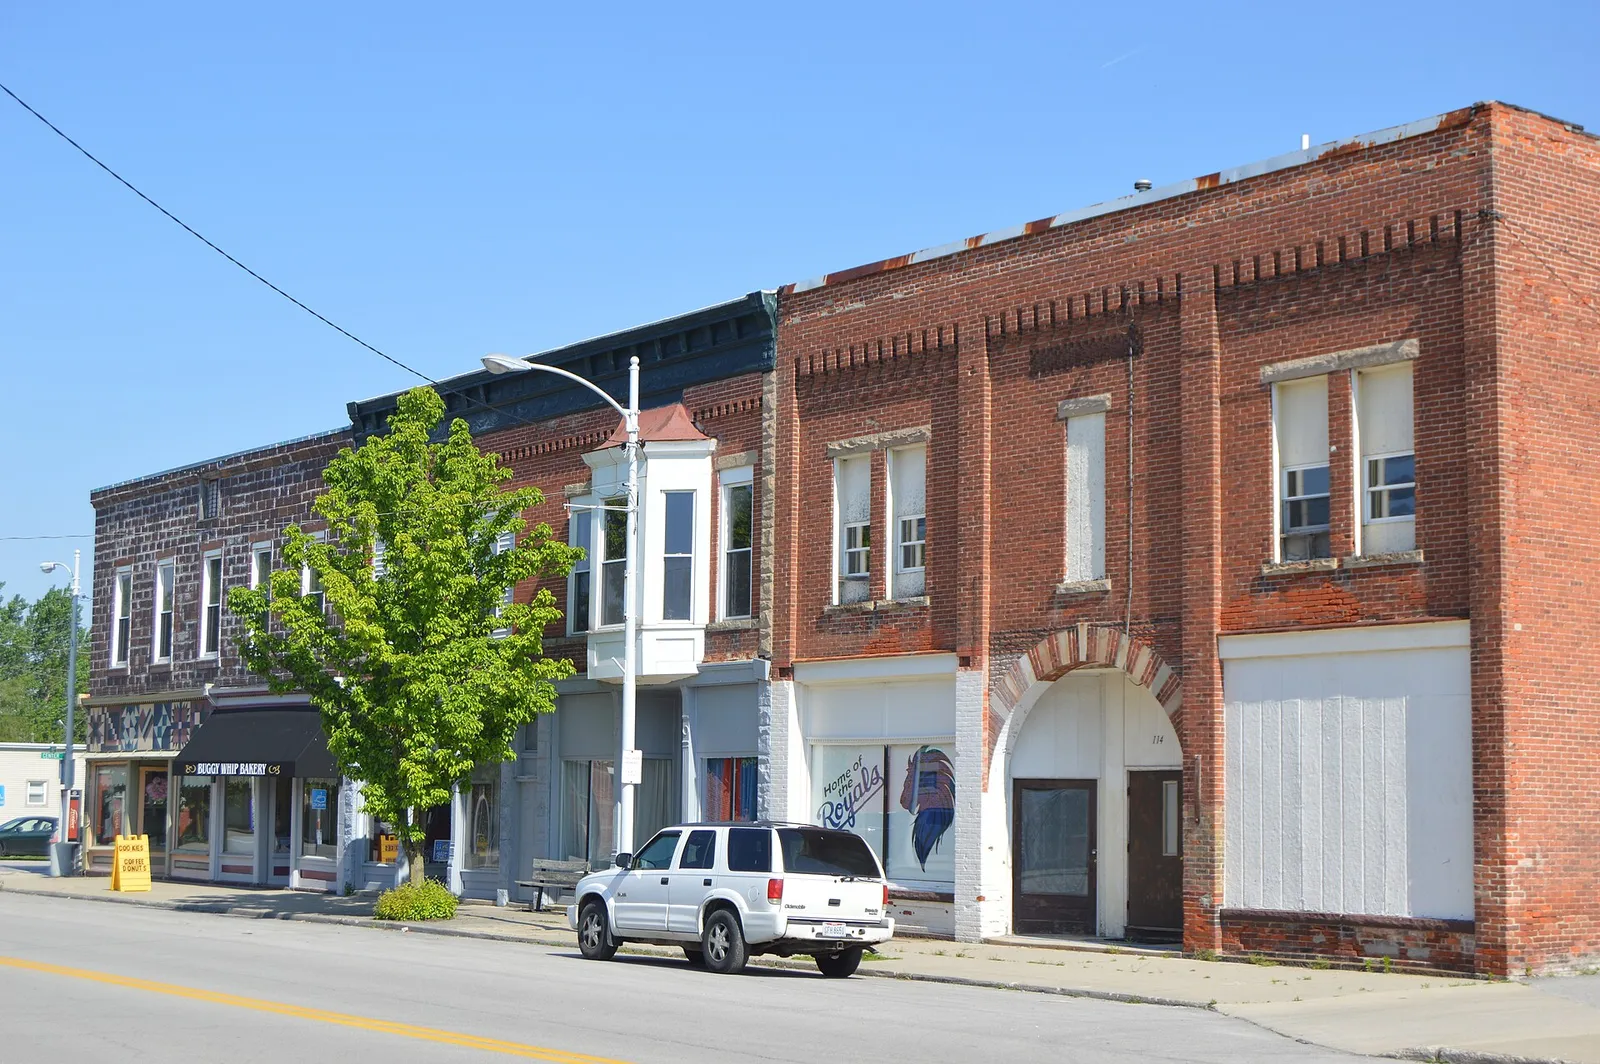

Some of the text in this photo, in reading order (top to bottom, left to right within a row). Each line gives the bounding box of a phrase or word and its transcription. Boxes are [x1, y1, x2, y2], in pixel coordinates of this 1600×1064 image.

[1152, 735, 1164, 744] 114
[197, 763, 267, 775] BUGGY WHIP BAKERY
[824, 754, 862, 797] Home of
[817, 765, 884, 829] Royals
[838, 779, 853, 797] the
